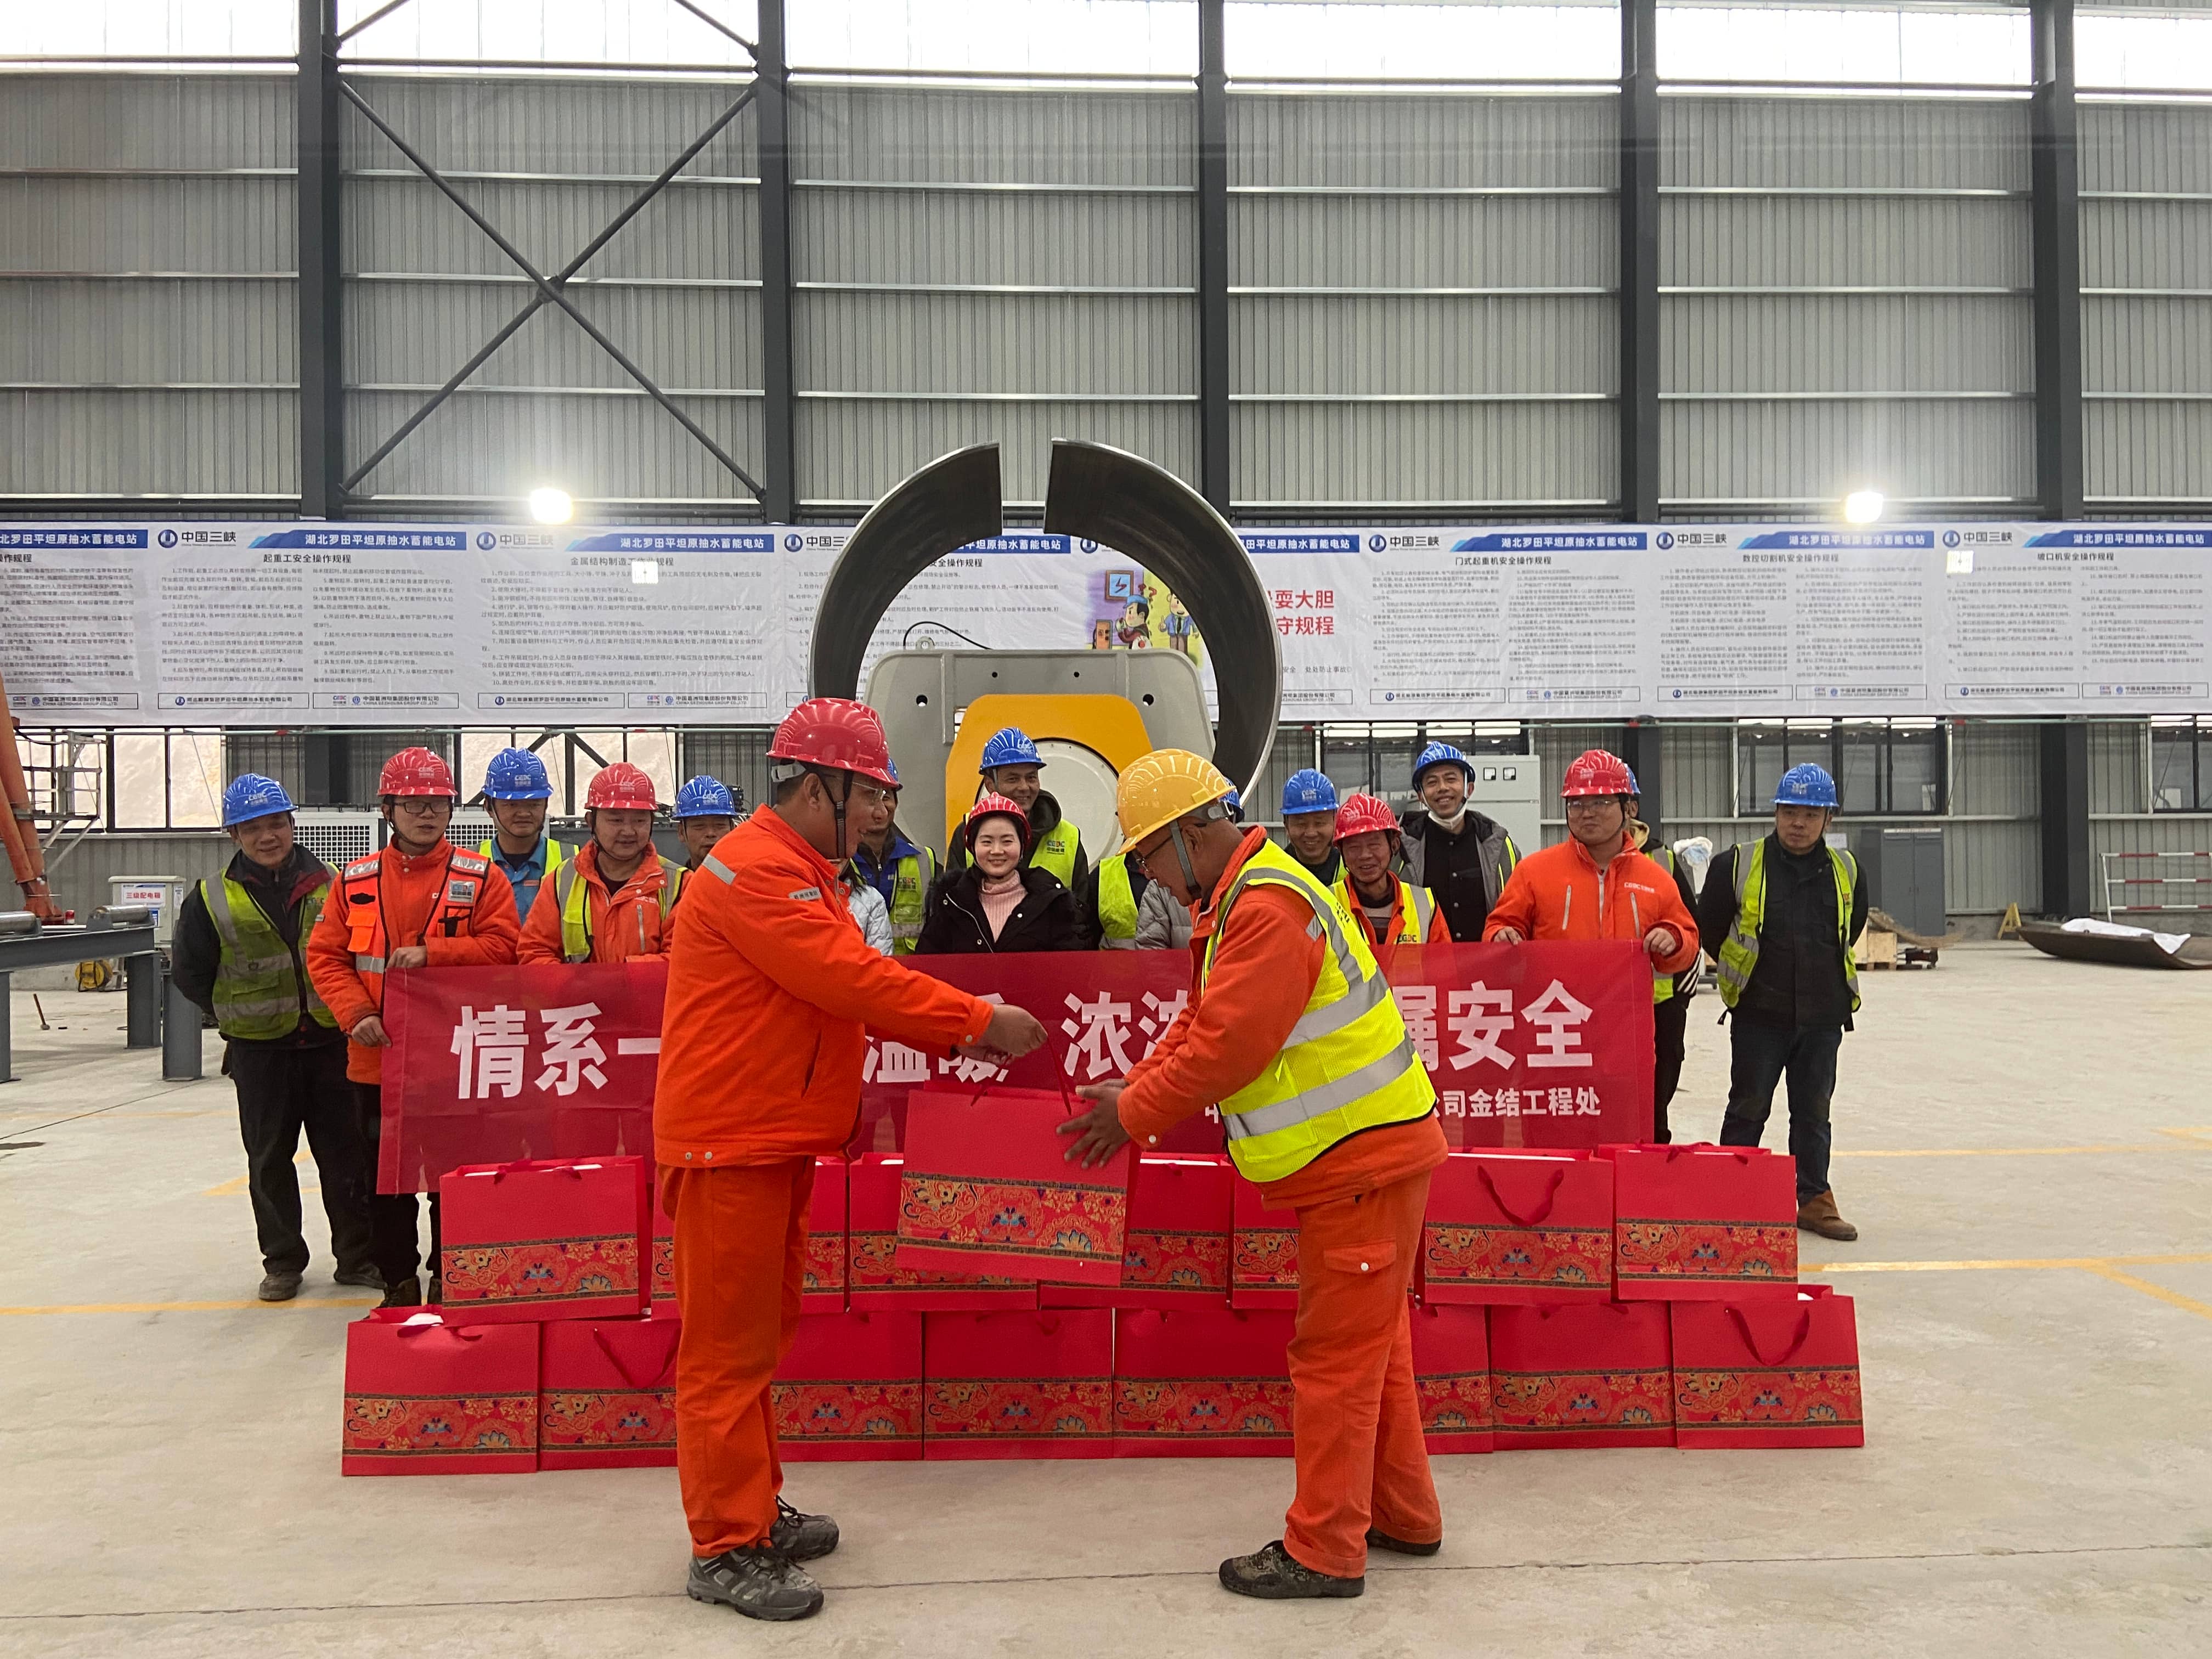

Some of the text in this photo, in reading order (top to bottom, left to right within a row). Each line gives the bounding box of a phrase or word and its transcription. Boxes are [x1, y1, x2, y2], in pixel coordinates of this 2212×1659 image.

[182, 532, 236, 543] 中国三峡
[305, 534, 456, 546] 湖北罗田平坦原抽水蓄能电站
[500, 534, 553, 545] 中国三峡
[806, 535, 849, 547] 中国三
[1390, 535, 1440, 547] 中国三峡
[1501, 536, 1638, 548] 湖北罗田平坦原抽水蓄能电站
[1677, 533, 1727, 544] 中国三峡
[1788, 534, 1925, 546] 湖北罗田平坦原抽水蓄能电站
[1963, 531, 2012, 543] 中国三峡
[2073, 533, 2204, 545] 湖北罗田平坦原抽水蓄能电站
[620, 538, 764, 549] 湖北罗田平坦原抽水蓄能电站
[958, 539, 1061, 550] 平坦原抽水蓄能电站
[263, 554, 352, 563] 起重工安全操作规程
[1455, 555, 1551, 566] 门式起重机安全操作规程
[1743, 553, 1839, 563] 数控切割机安全操作规程
[2037, 552, 2114, 562] 坡口机安全操作规程
[1267, 590, 1334, 609] 耍大胆
[1276, 616, 1334, 635] 守规程
[450, 1002, 661, 1099] 情系一
